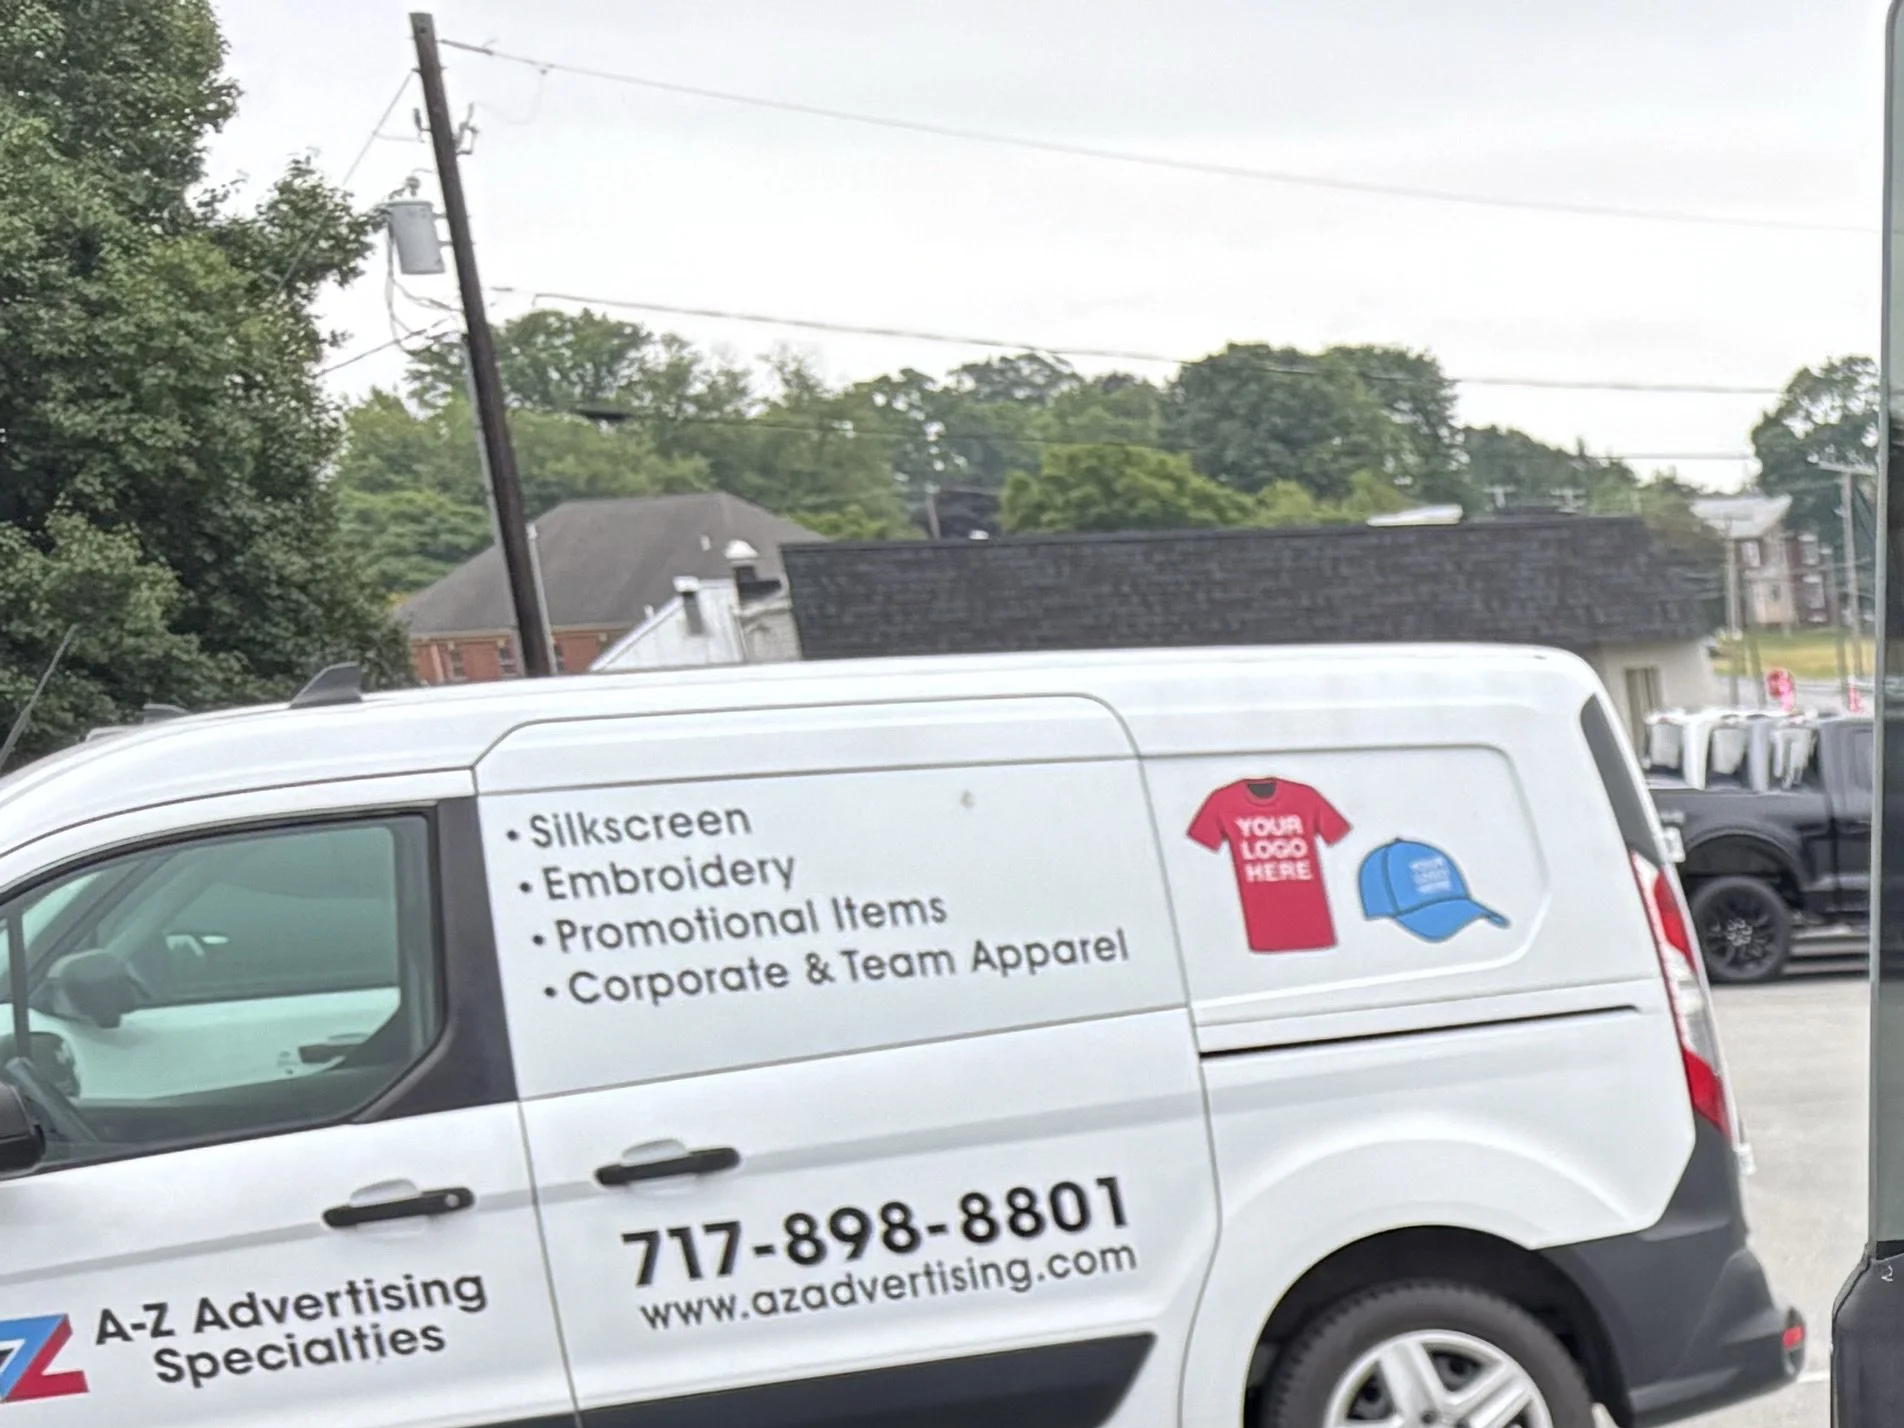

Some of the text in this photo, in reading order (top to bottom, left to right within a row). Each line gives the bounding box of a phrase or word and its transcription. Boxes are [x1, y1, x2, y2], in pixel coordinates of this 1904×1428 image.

[530, 808, 752, 848] Silkscreen
[1234, 814, 1304, 837] YOUR
[1241, 837, 1308, 860] LOGO
[543, 854, 794, 900] Embroidery
[1244, 859, 1313, 883] HERE
[556, 896, 948, 953] Promotional Items
[568, 926, 1129, 1006] Corporate & Team Apparel
[621, 1176, 1128, 1287] 717-898-8801
[96, 1273, 487, 1346] A-Z Advertising
[639, 1244, 1137, 1330] www.azadvertising.com
[153, 1322, 446, 1389] Specialties
